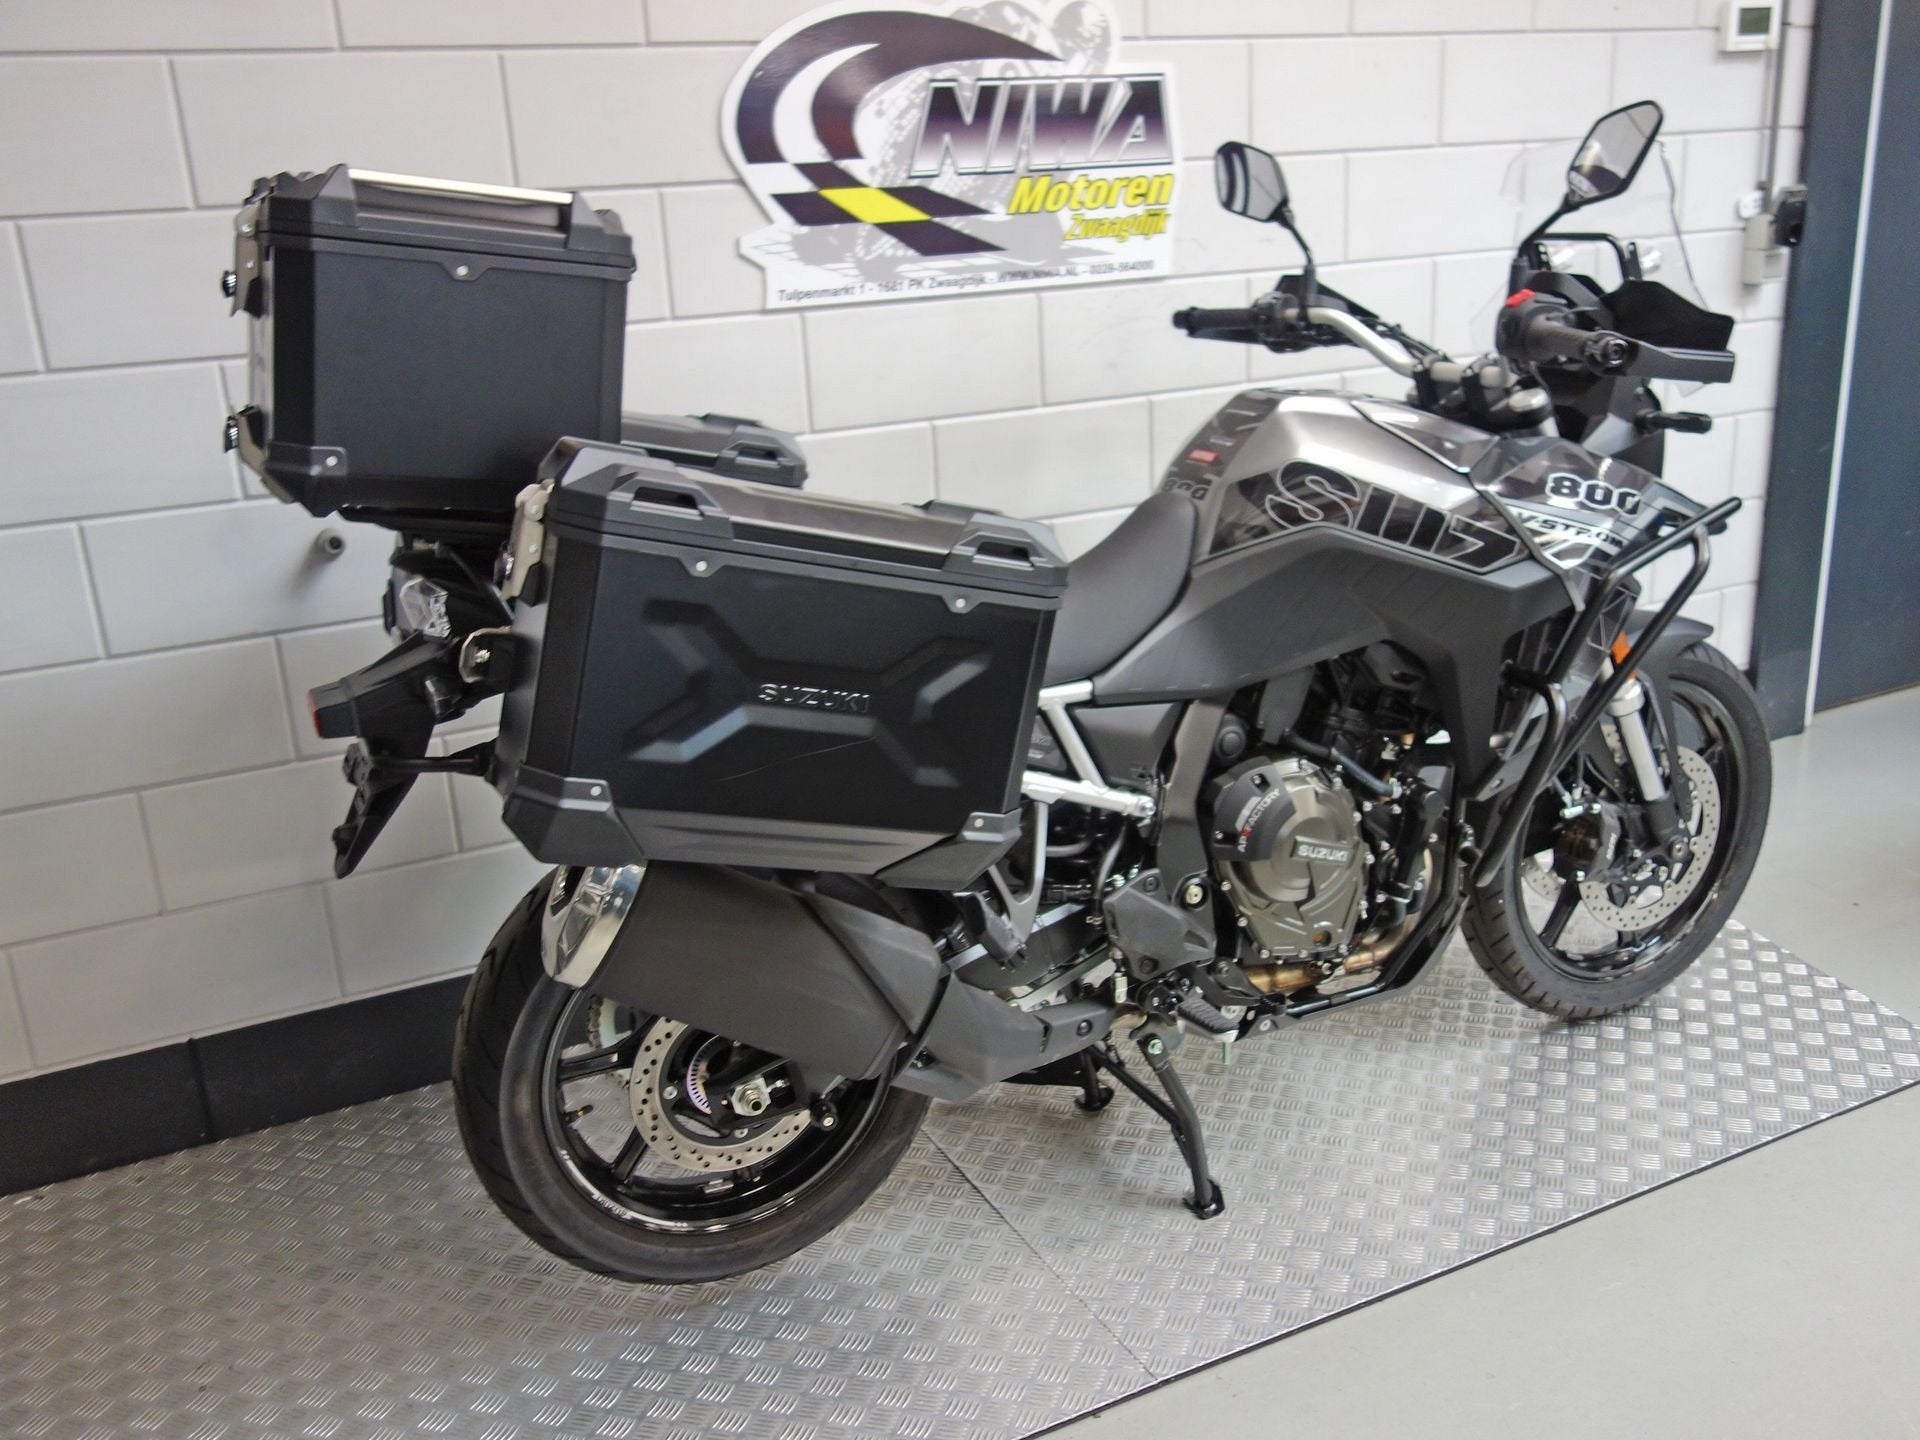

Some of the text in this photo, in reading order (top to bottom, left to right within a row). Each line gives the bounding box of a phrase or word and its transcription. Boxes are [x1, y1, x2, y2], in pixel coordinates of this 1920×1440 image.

[908, 73, 1174, 178] NIWA
[1007, 173, 1175, 215] Motoren
[1063, 208, 1170, 242] Zwaagdijk
[1545, 472, 1641, 518] 800
[758, 683, 871, 713] SUZUKI
[1297, 843, 1349, 862] SUZUKI
